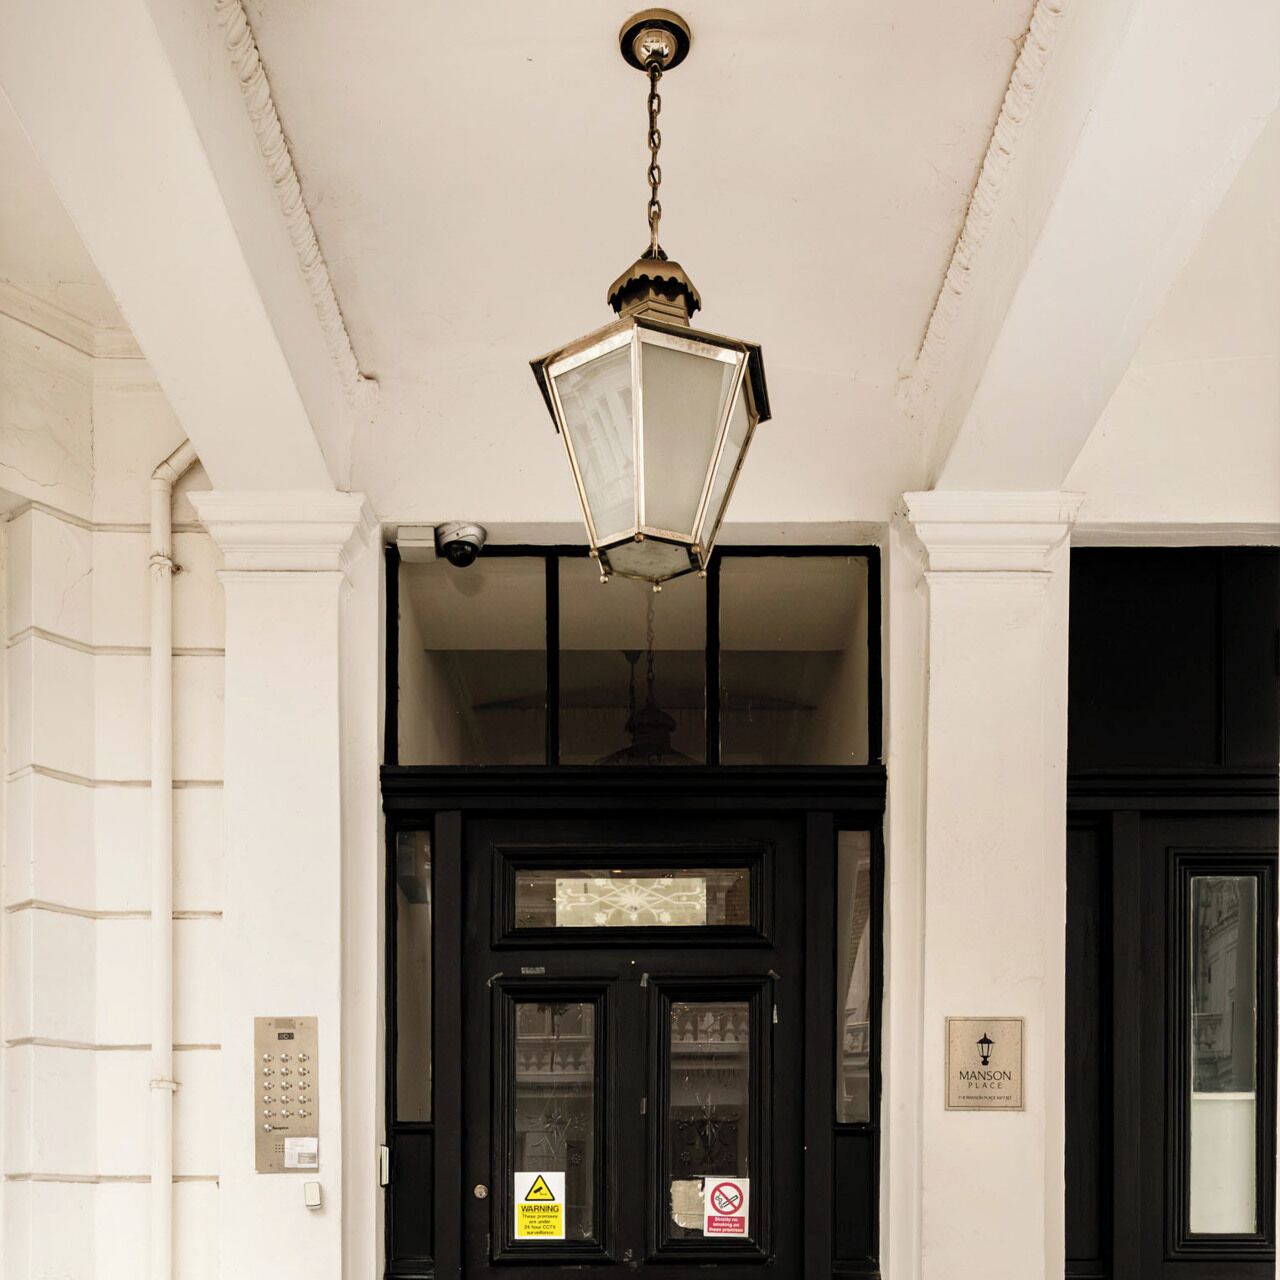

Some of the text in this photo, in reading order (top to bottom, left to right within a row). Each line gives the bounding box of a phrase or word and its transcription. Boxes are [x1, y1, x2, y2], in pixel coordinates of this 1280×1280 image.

[959, 1070, 1012, 1081] MANSON
[968, 1081, 1003, 1089] PLACE
[520, 1205, 560, 1213] WARNING
